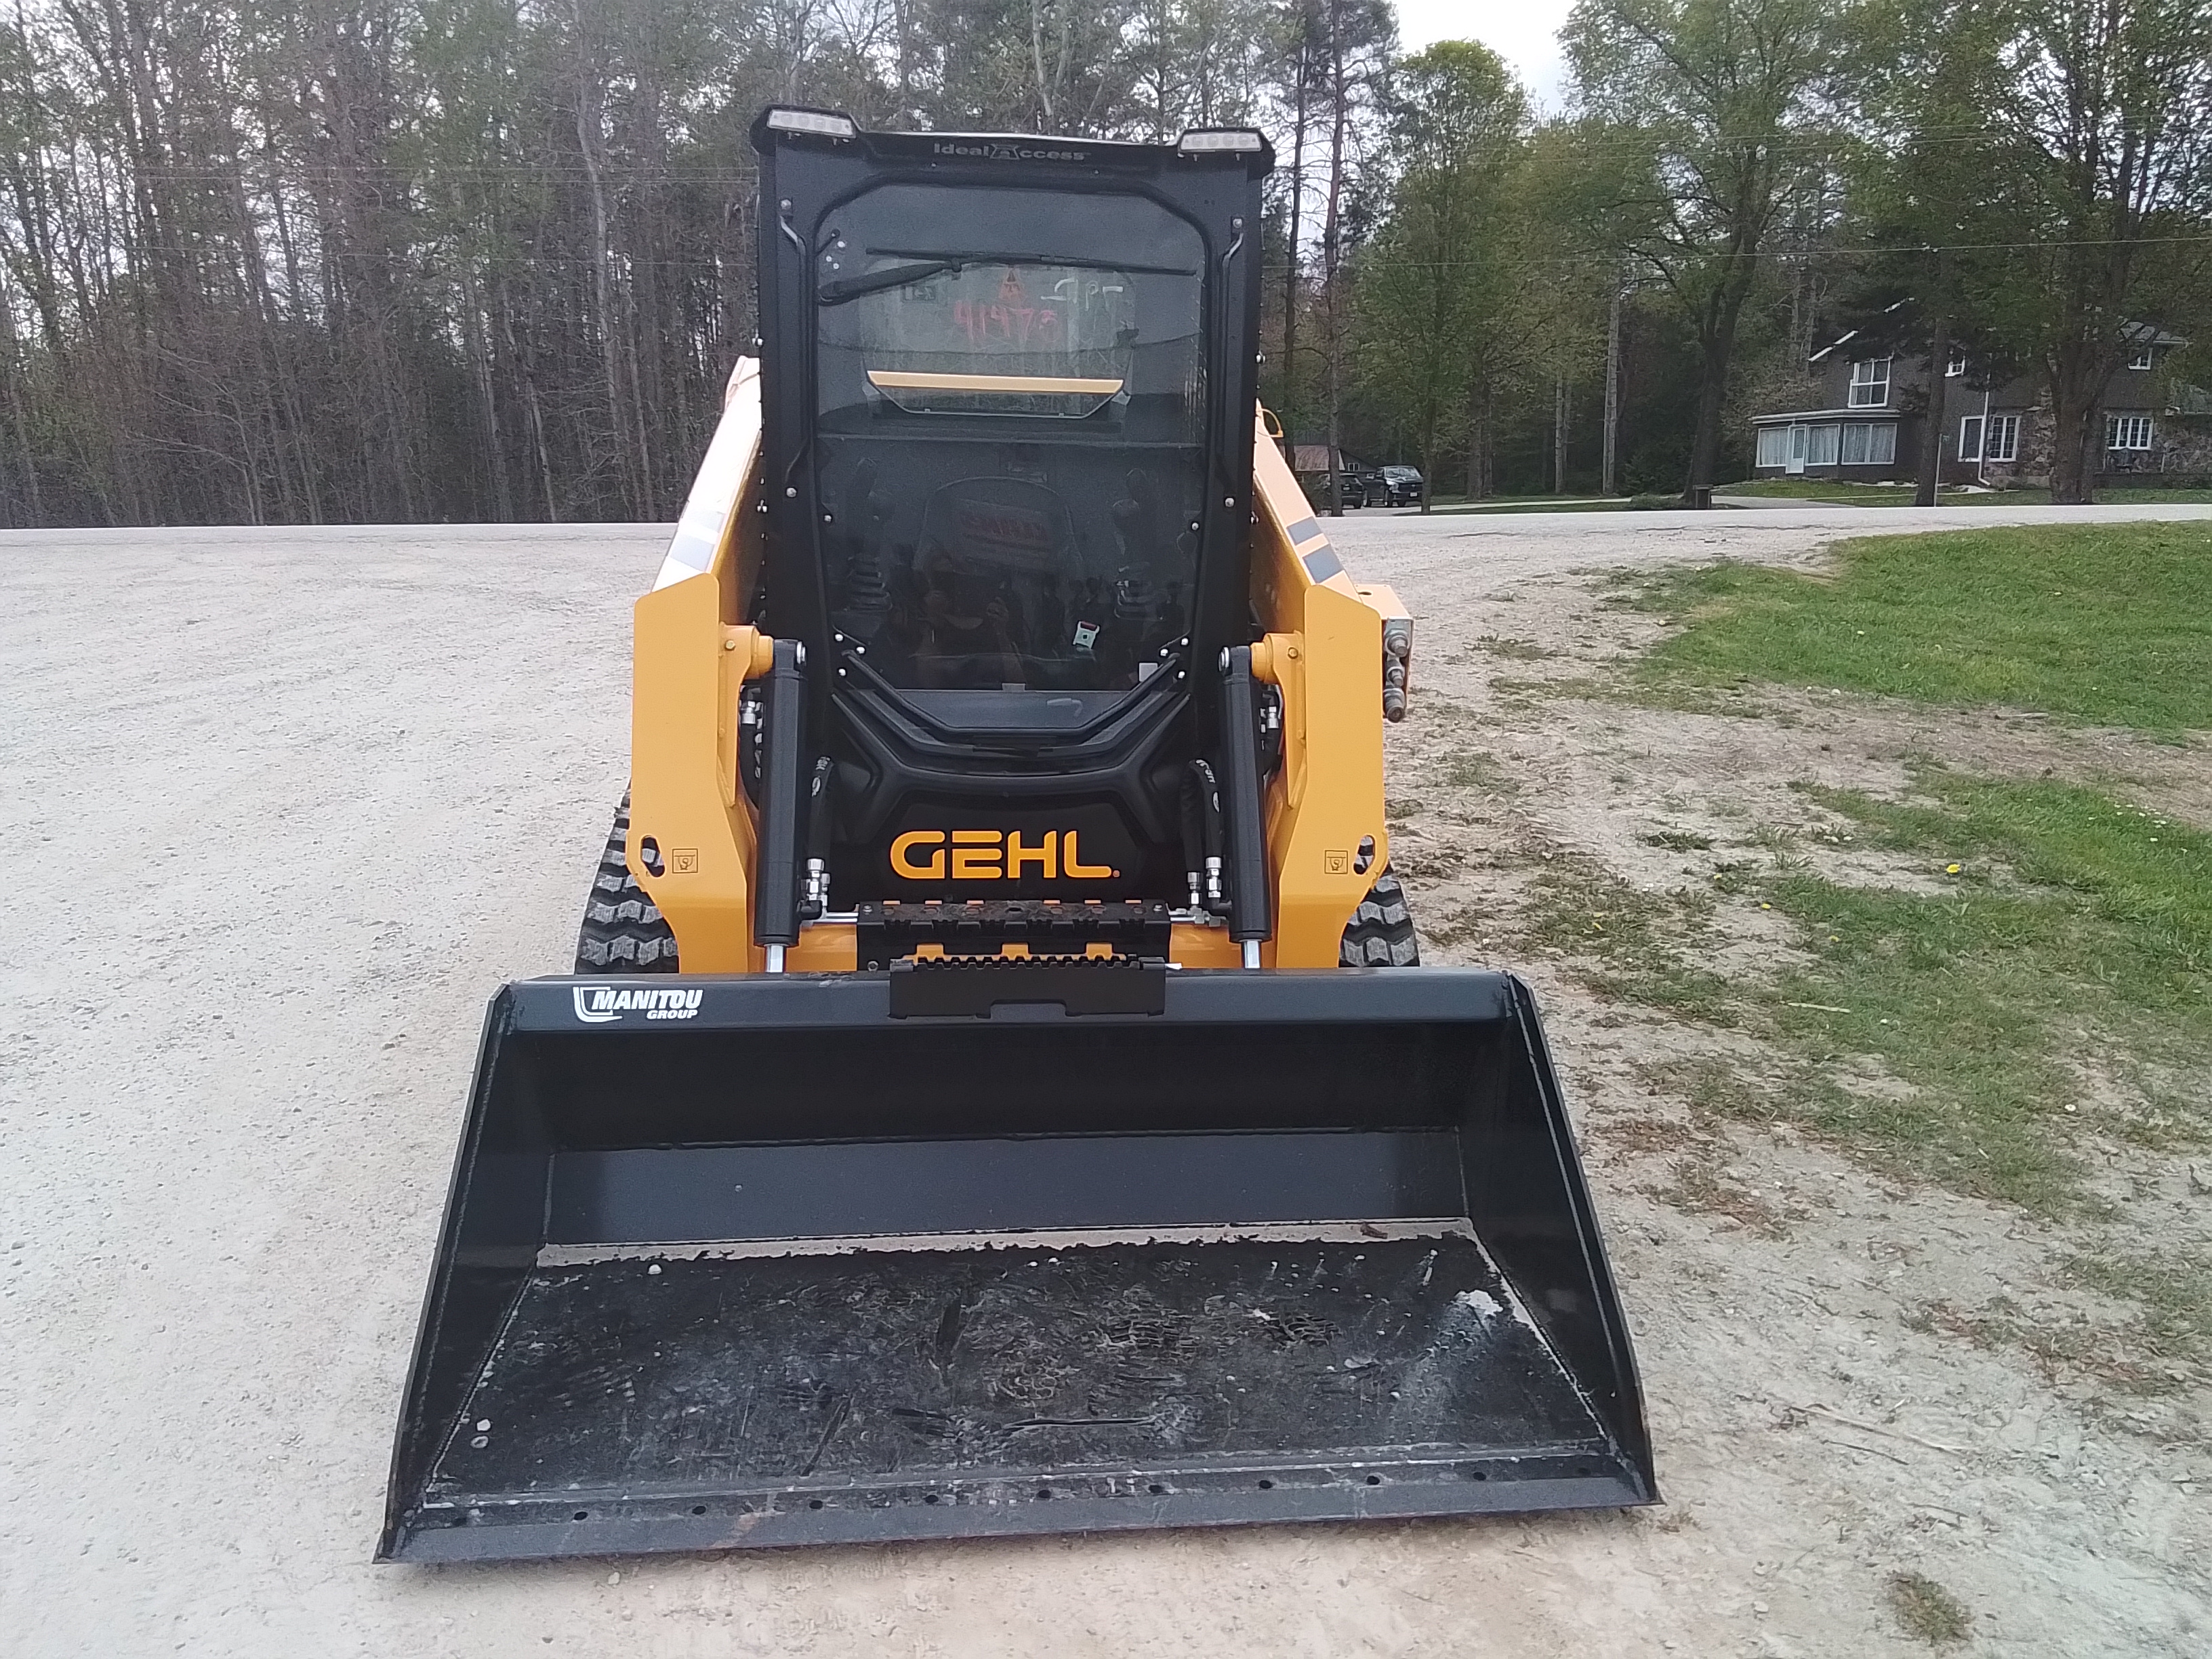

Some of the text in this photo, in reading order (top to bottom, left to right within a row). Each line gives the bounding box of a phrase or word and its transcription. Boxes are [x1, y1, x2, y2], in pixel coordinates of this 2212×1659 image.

[934, 143, 989, 157] Ideal
[890, 830, 1112, 879] GEHL
[592, 989, 703, 1010] MANITOU
[647, 1009, 698, 1019] GROUP
